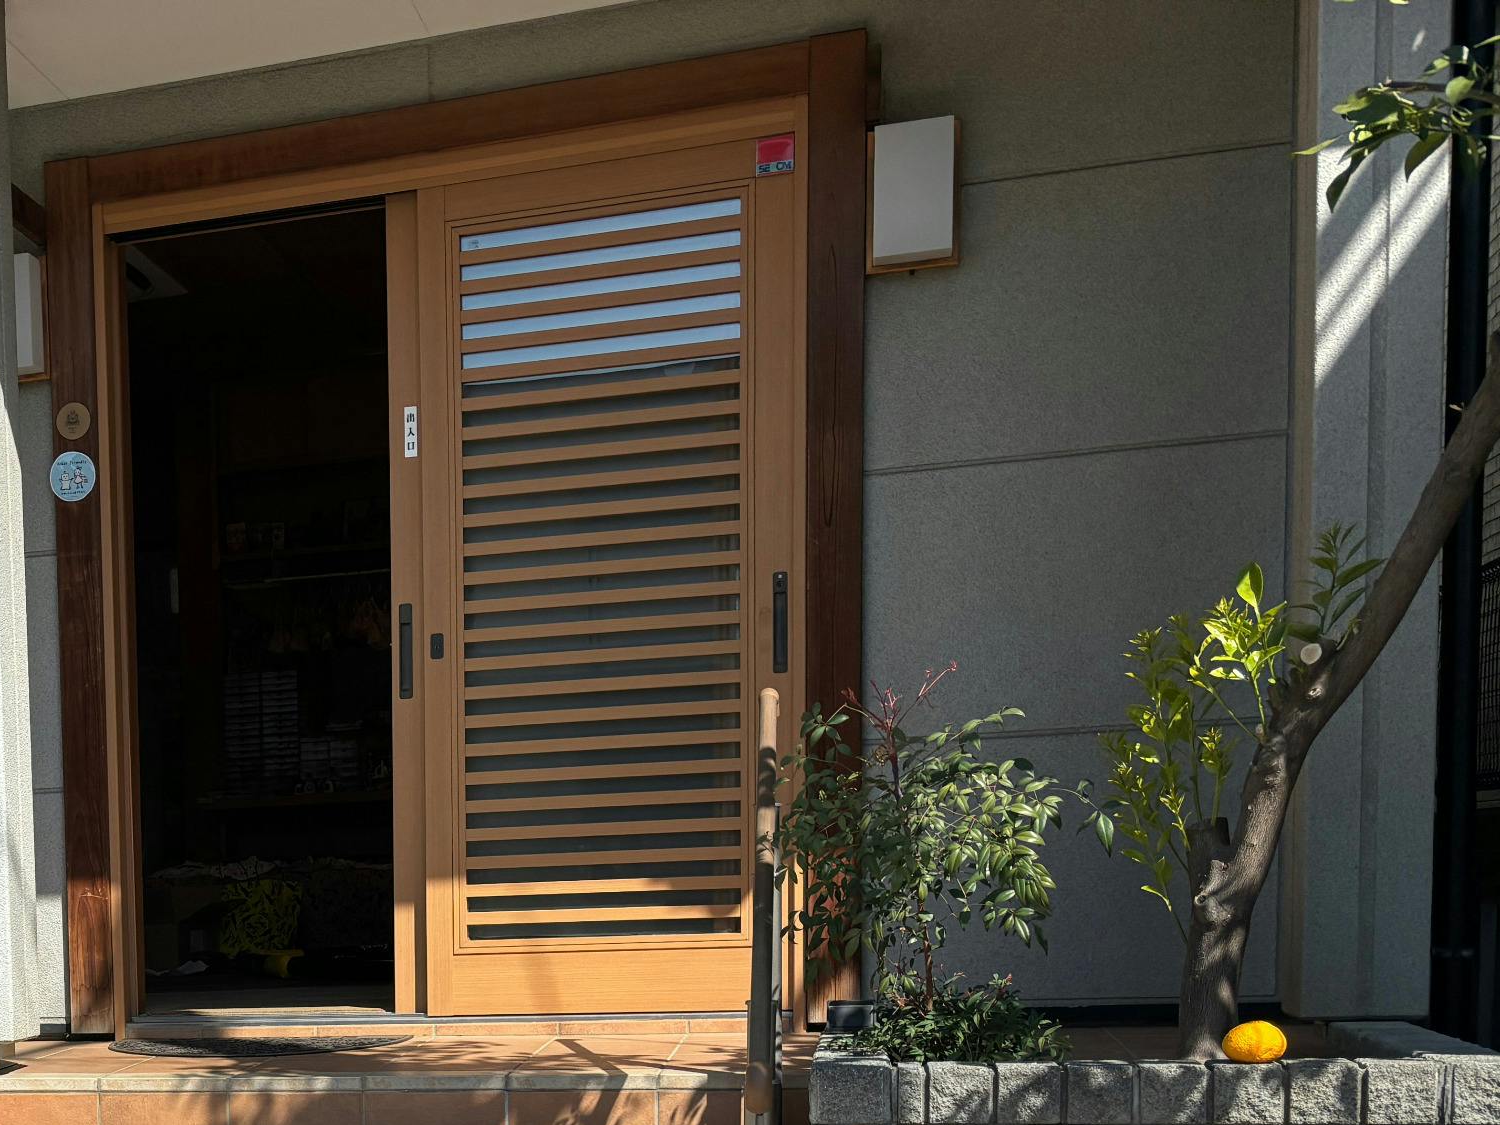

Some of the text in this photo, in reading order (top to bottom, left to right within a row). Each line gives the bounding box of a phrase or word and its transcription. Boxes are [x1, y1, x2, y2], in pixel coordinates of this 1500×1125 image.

[758, 161, 792, 173] SEOM
[406, 412, 415, 451] 出入口
